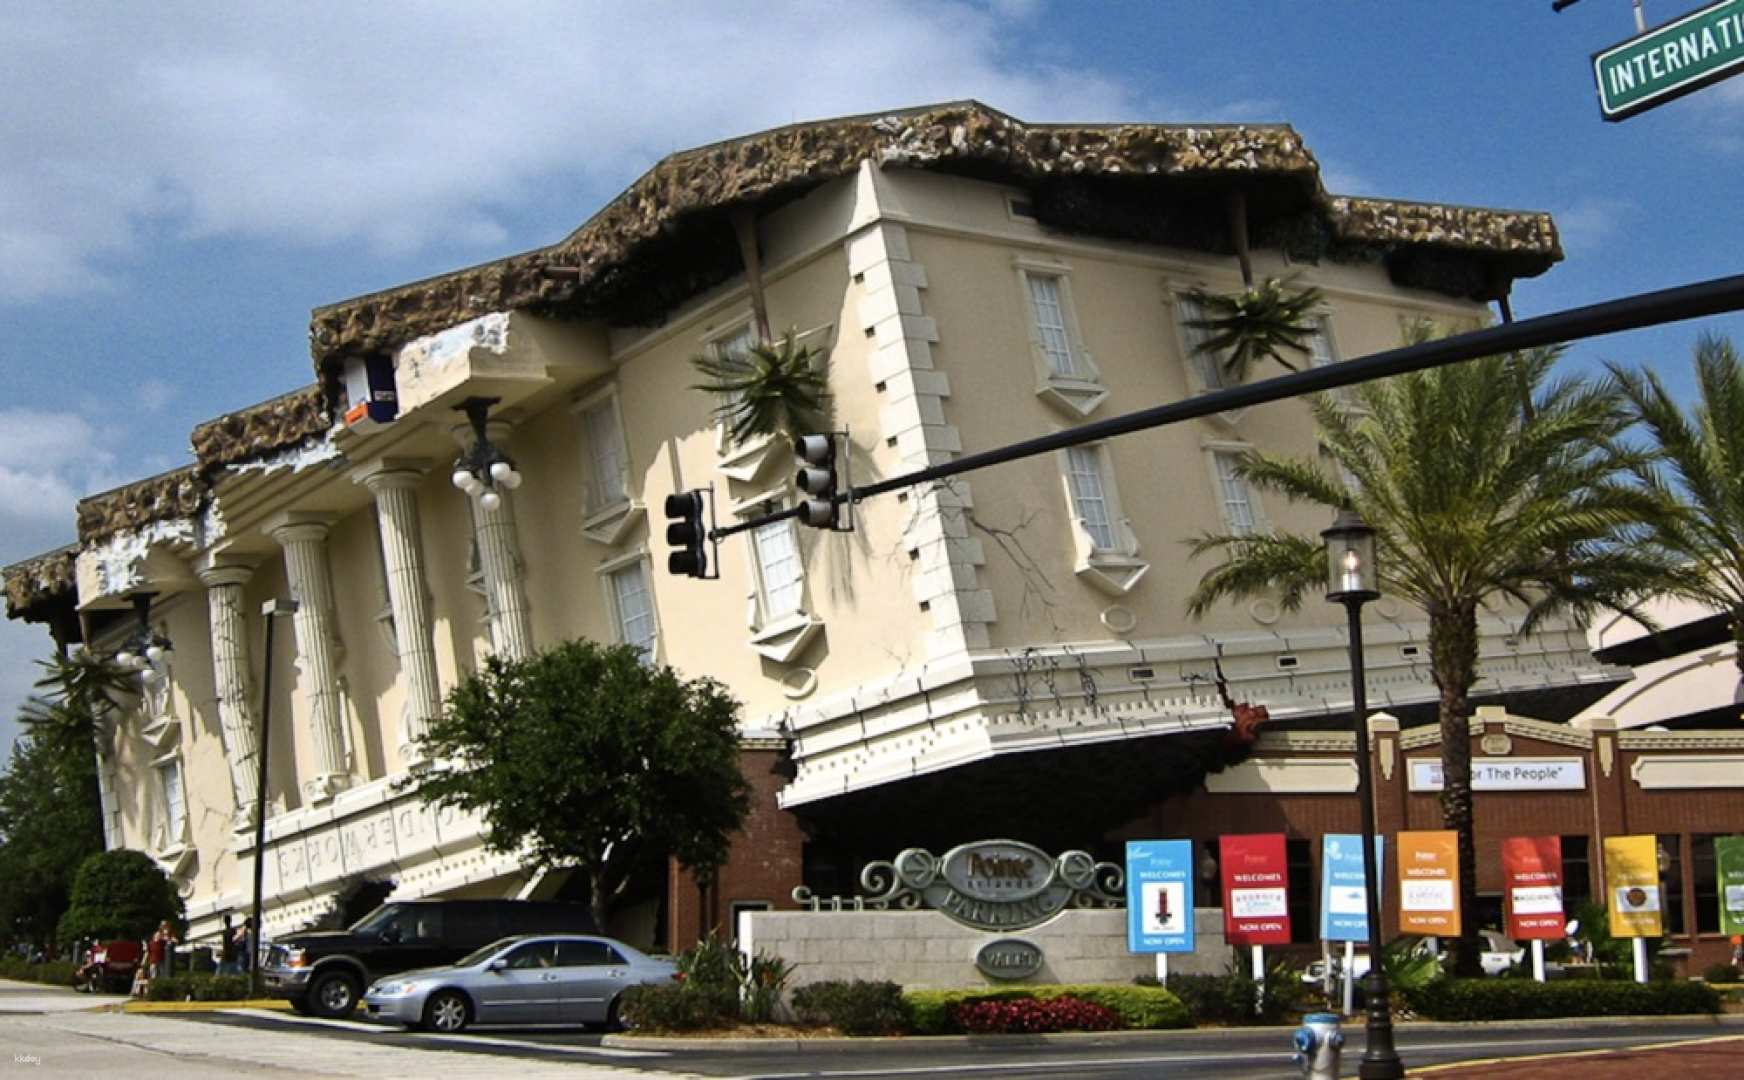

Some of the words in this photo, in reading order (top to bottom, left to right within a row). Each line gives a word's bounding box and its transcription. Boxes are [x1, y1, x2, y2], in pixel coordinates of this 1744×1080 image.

[1609, 13, 1744, 96] INTERNATI
[1487, 767, 1511, 780] The
[1233, 873, 1282, 882] WELCOMES
[1515, 873, 1558, 881] WELCOMES
[944, 888, 1058, 925] PARKING
[1239, 924, 1259, 932] NOW
[1260, 923, 1283, 931] OPEN
[1519, 920, 1538, 928] NOW
